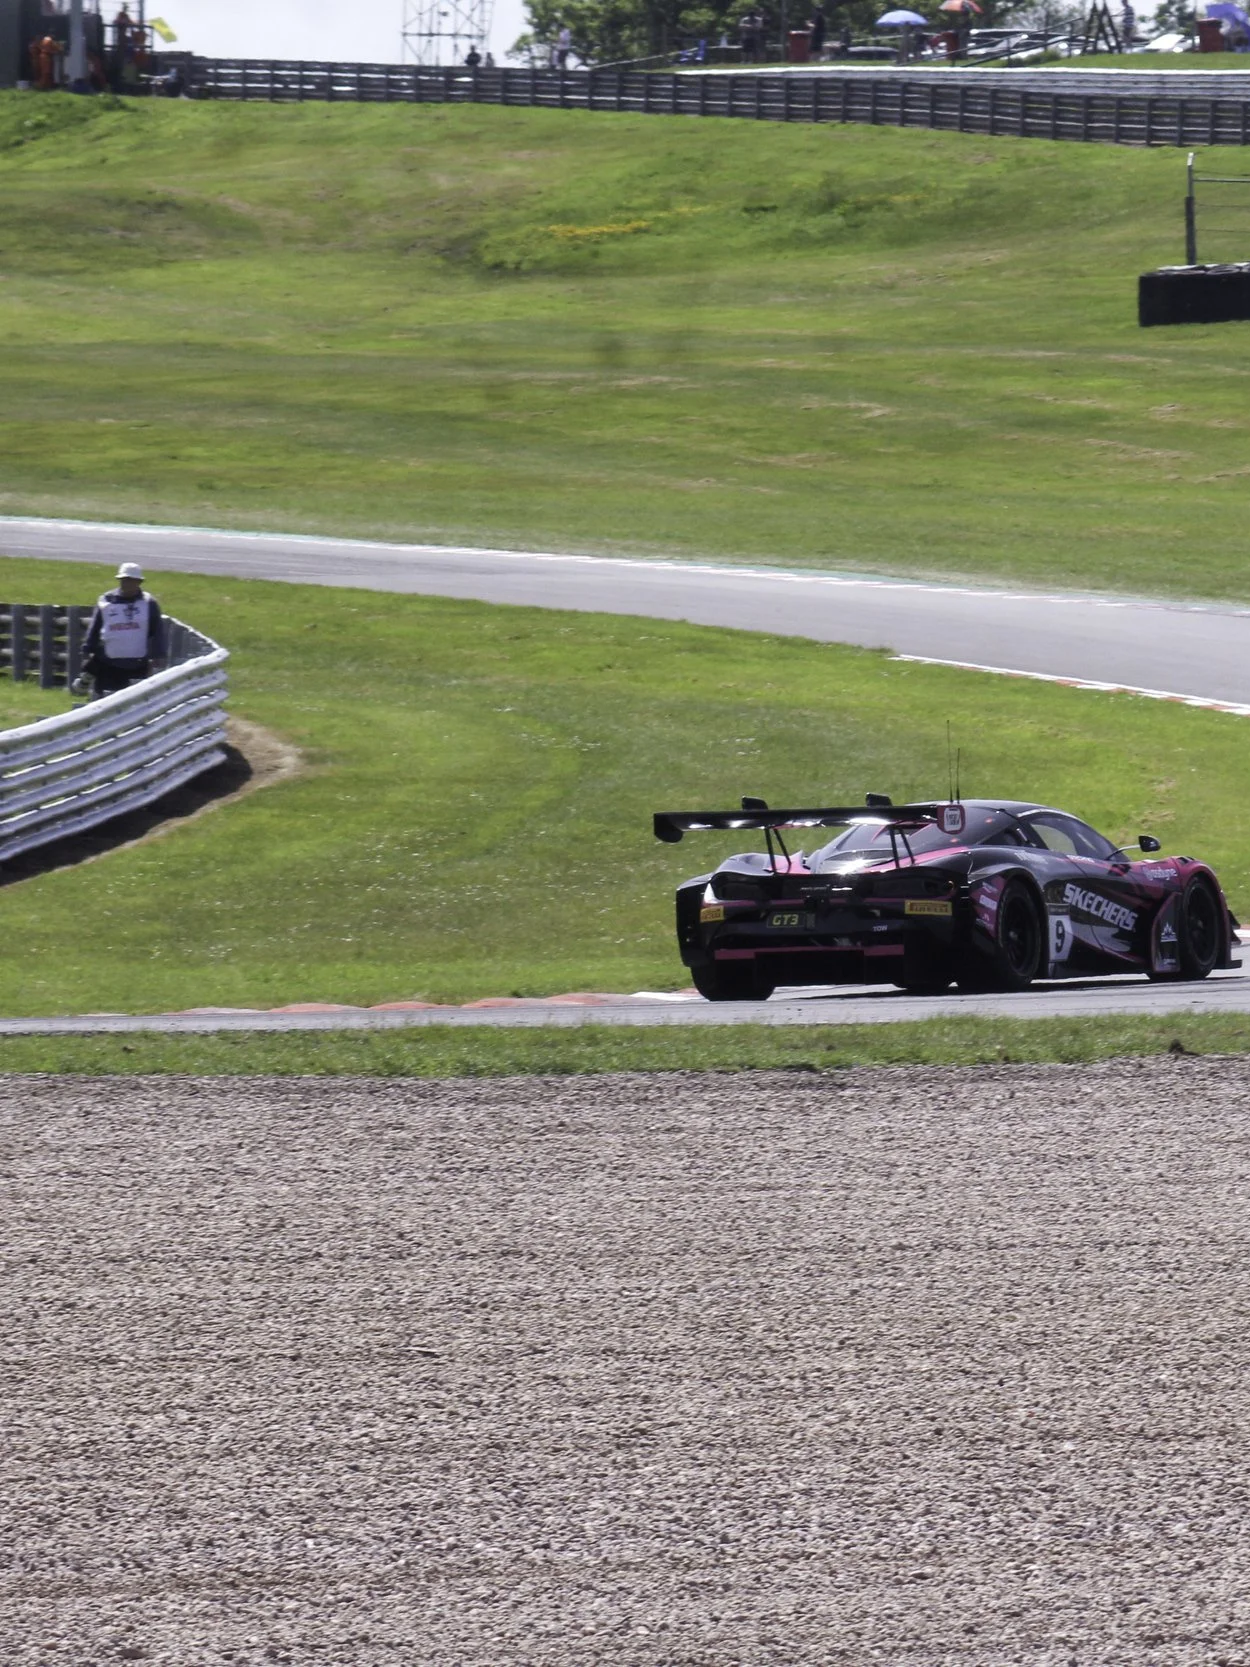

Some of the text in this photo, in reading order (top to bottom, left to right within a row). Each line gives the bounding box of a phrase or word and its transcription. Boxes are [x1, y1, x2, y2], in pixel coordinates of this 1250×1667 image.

[772, 914, 800, 926] GT3
[1063, 883, 1138, 931] SKECHERS
[1055, 919, 1066, 953] 9
